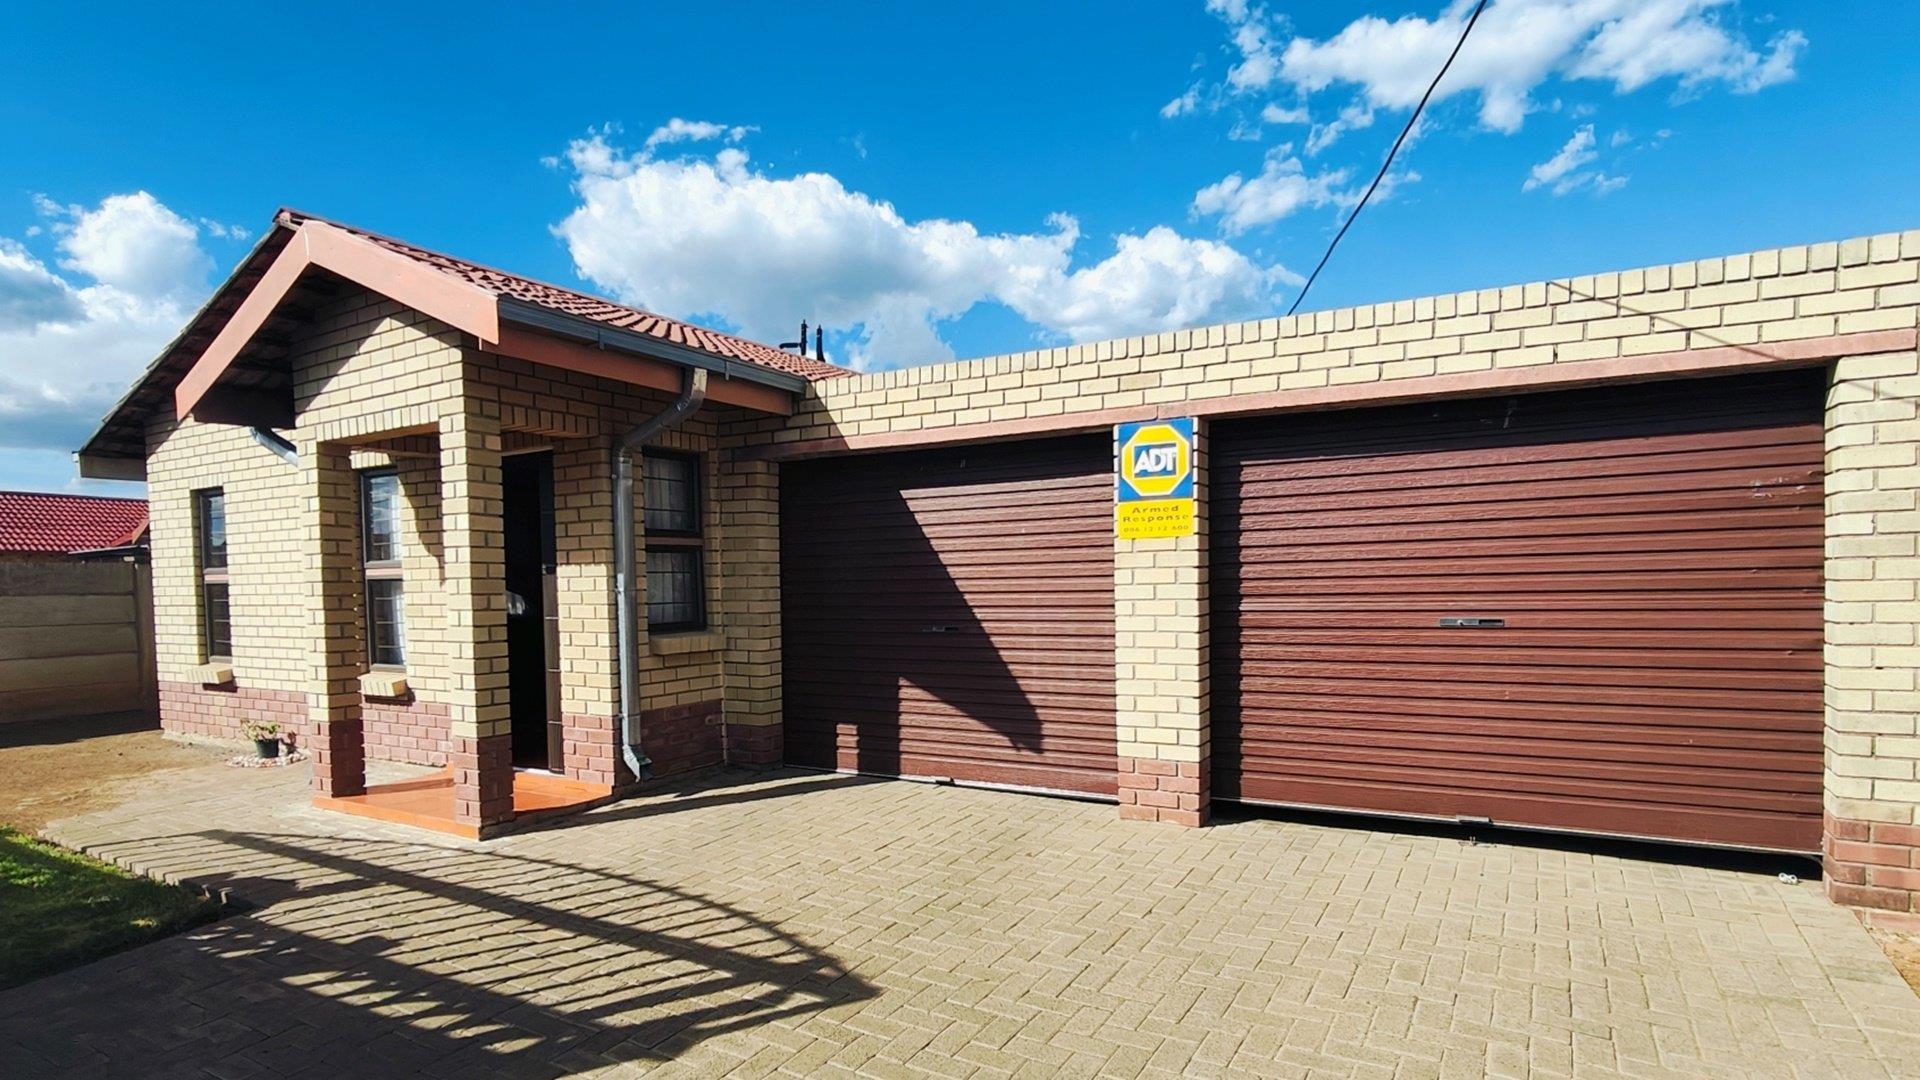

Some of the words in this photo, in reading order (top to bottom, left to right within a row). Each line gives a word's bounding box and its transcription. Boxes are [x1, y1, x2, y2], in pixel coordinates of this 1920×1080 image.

[1133, 447, 1176, 474] ADT
[1132, 505, 1179, 514] Armed
[1123, 514, 1189, 523] Response
